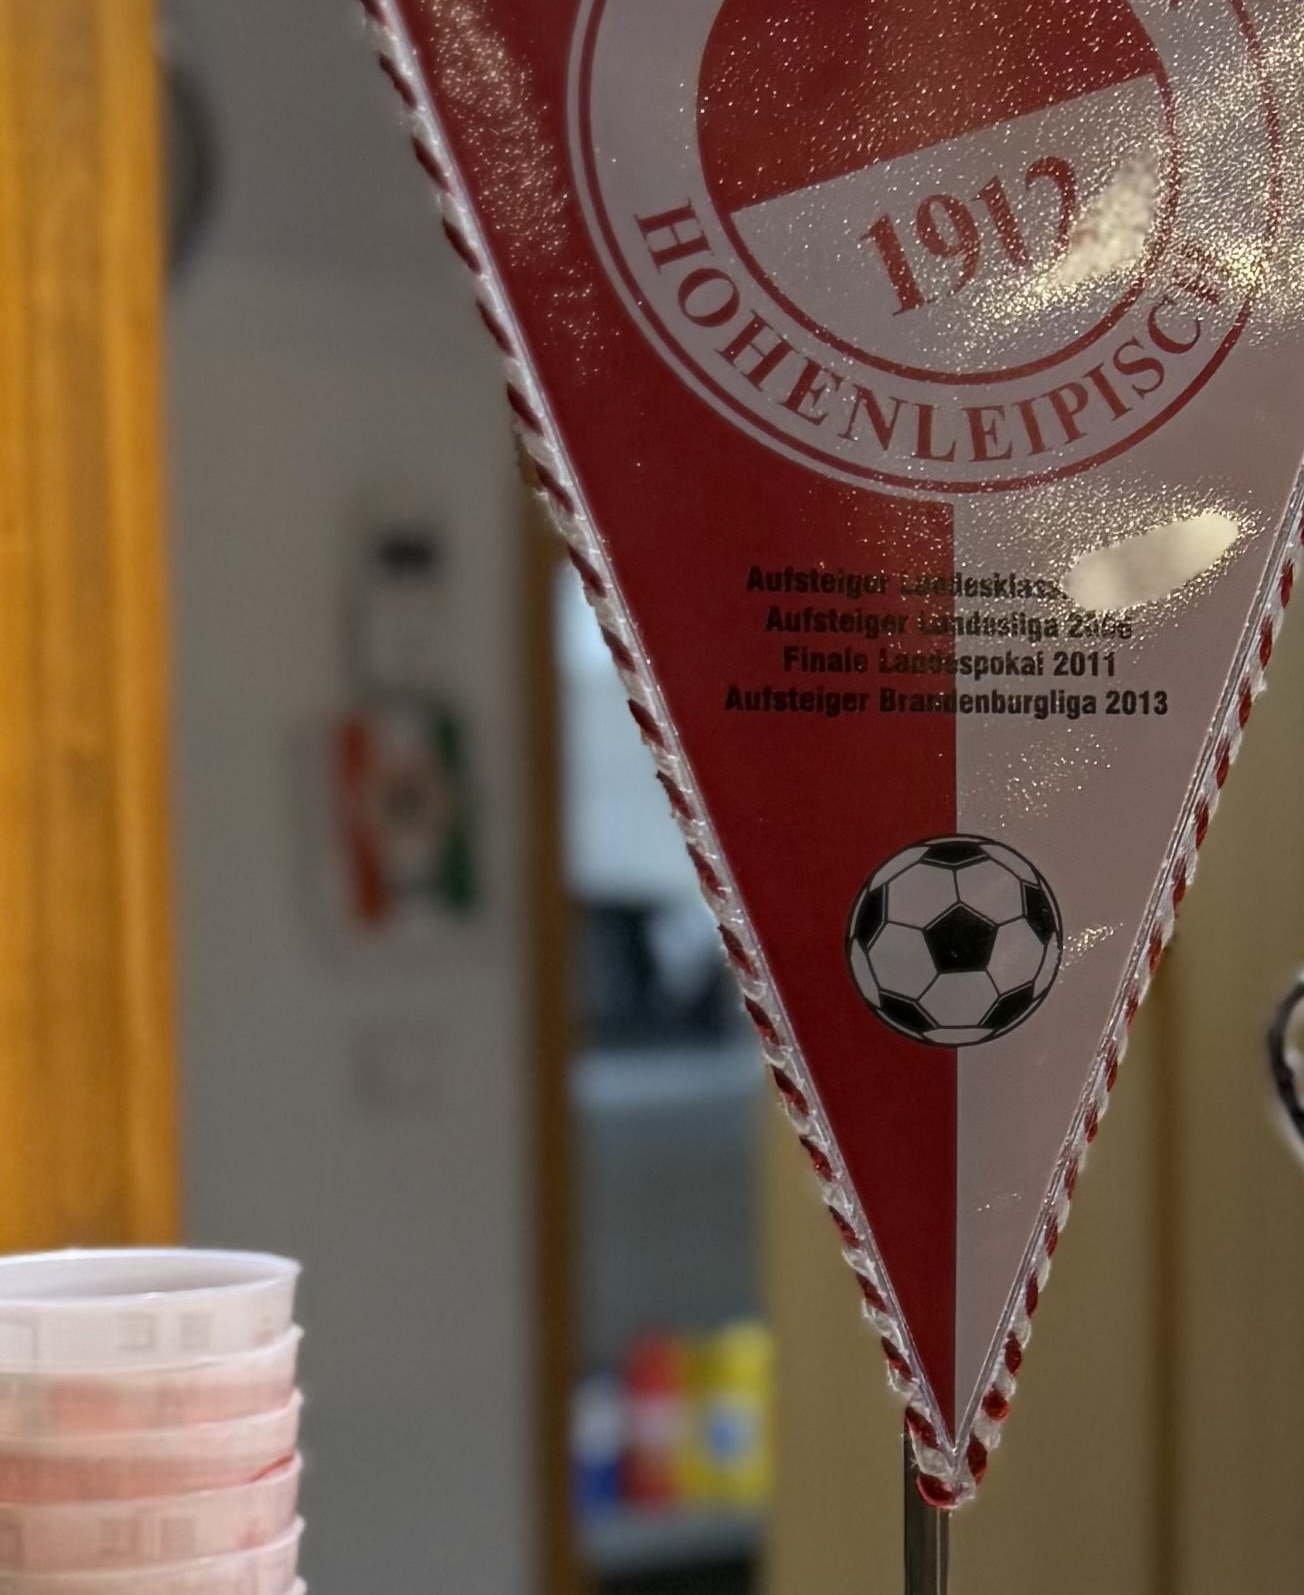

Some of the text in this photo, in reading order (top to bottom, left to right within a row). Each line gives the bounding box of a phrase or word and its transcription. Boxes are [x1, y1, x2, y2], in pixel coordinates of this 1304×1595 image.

[747, 565, 889, 596] Aufsteiger
[765, 607, 907, 637] Aufsteiger
[783, 646, 1117, 682] Finale Landespokal 2011
[725, 685, 1169, 721] Aufsteiger Brandenburgliga 2013
